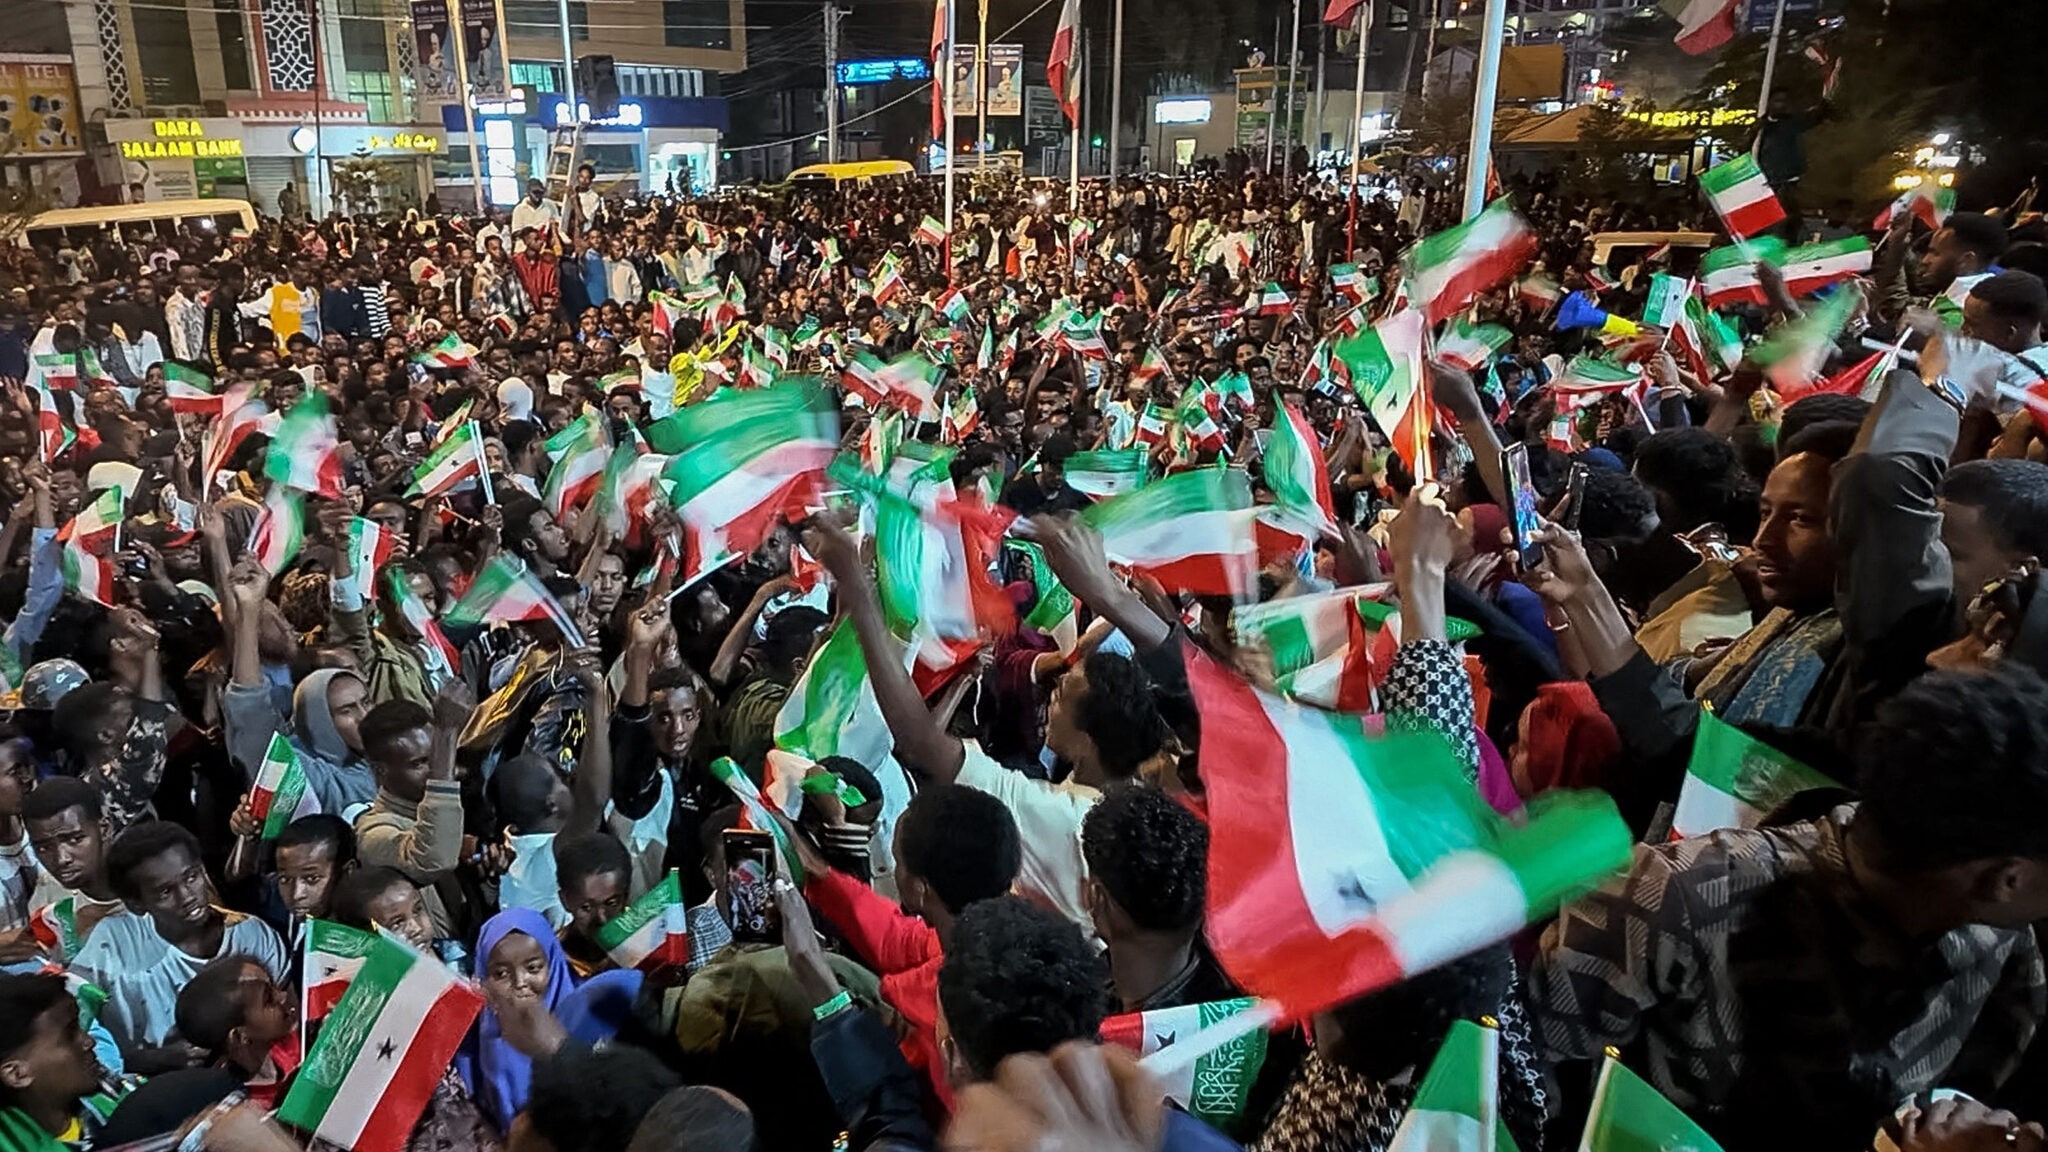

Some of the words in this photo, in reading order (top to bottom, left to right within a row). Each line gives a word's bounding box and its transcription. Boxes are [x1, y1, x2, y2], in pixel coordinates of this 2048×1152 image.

[24, 64, 66, 79] ITEL
[154, 120, 203, 137] DARA
[122, 140, 194, 158] SALAAM
[195, 139, 242, 156] BANK
